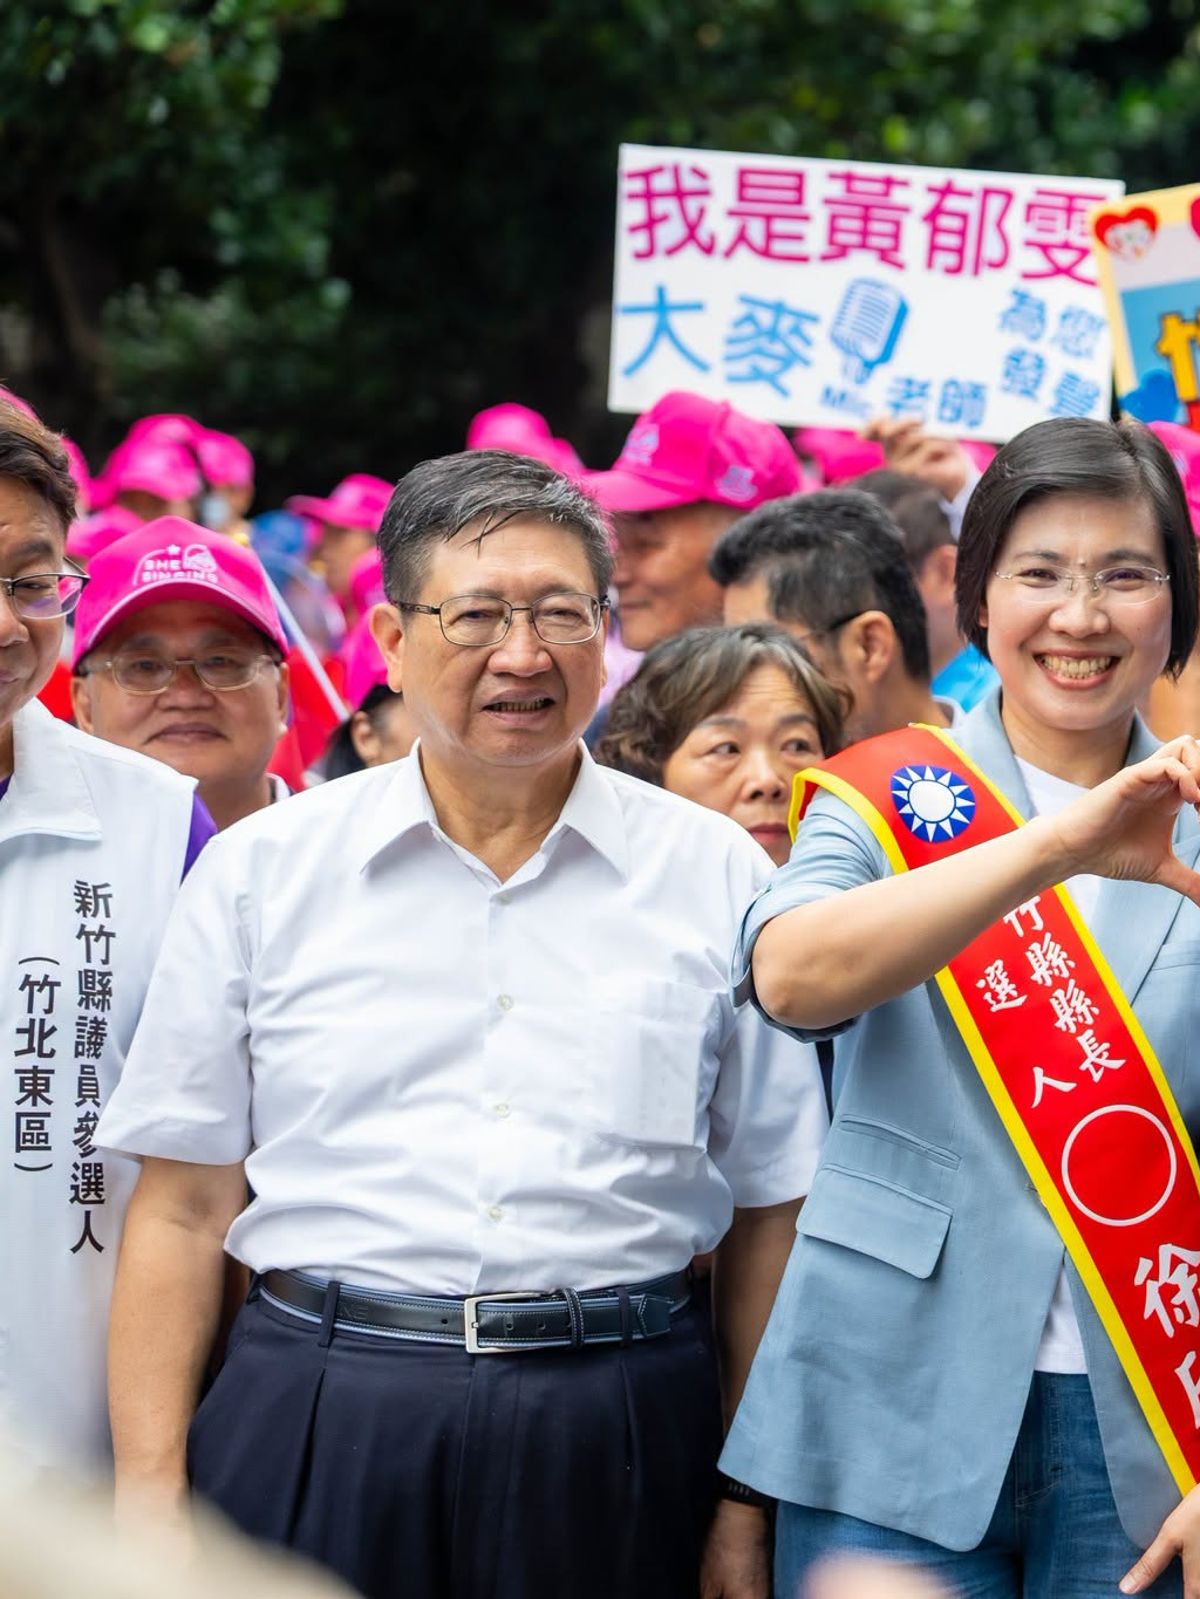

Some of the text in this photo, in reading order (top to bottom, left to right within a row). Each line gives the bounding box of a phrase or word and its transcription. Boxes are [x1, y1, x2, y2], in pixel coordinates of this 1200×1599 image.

[624, 162, 1108, 287] 我是黃郁雯
[617, 284, 819, 398] 大麥
[144, 559, 180, 571] SHE
[69, 879, 117, 1254] 新竹縣議員參選人
